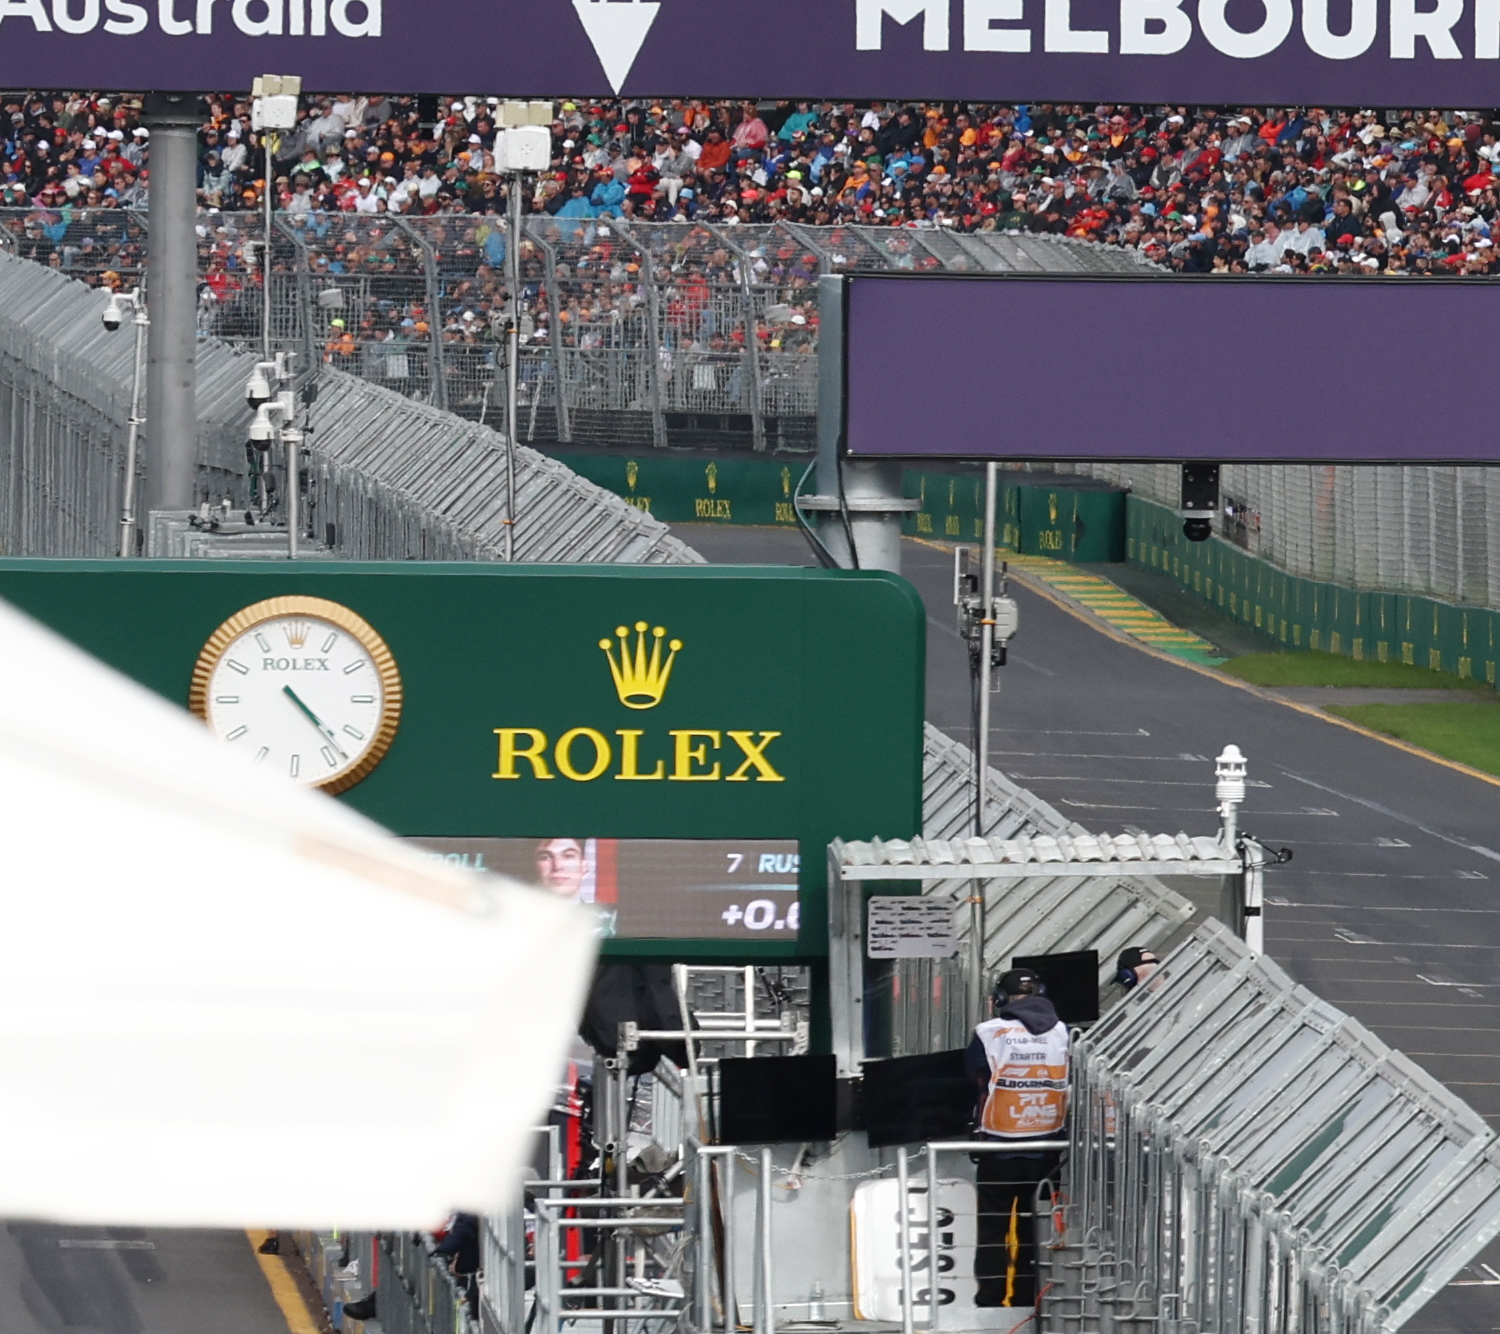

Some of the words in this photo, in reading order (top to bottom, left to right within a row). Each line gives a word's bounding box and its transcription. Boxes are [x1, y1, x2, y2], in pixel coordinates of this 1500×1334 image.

[695, 499, 732, 519] ROLEX
[261, 655, 332, 673] ROLEX
[491, 727, 786, 783] ROLEX
[726, 853, 745, 874] 7
[1009, 1051, 1047, 1061] STARTER
[1017, 1092, 1049, 1106] PIT
[1009, 1103, 1057, 1118] LANE
